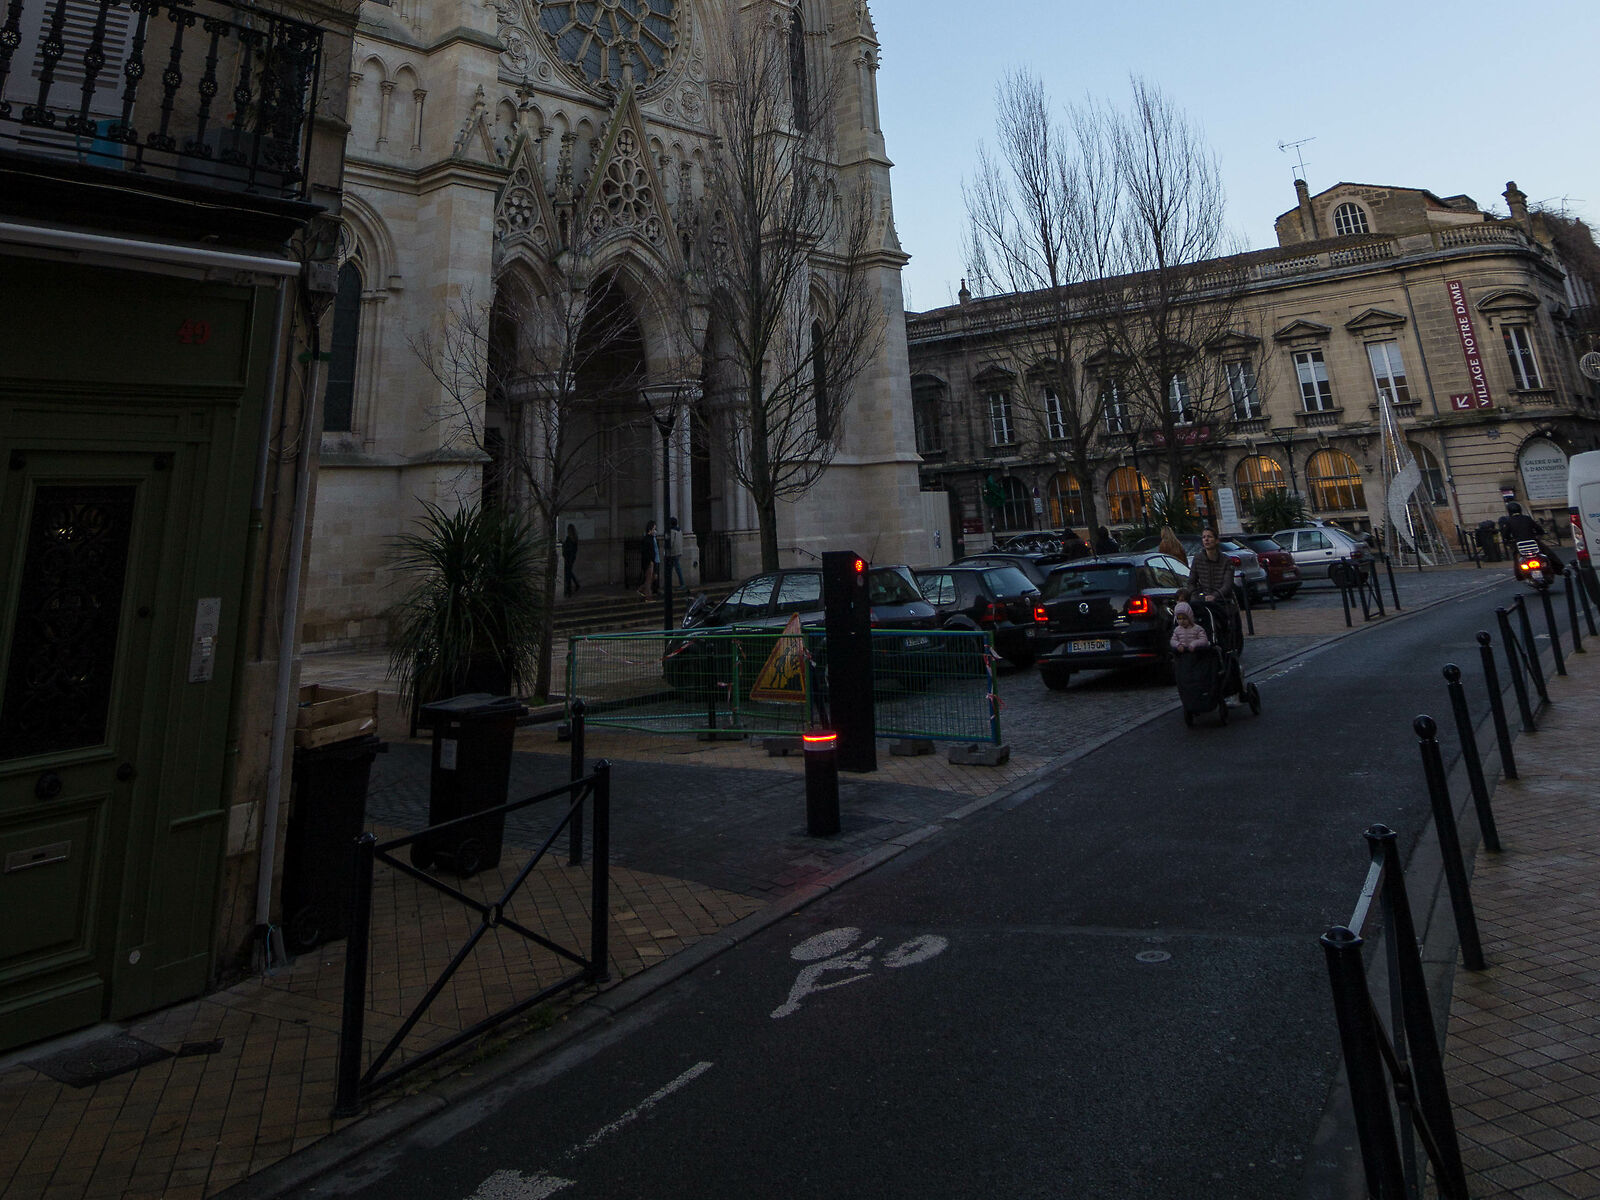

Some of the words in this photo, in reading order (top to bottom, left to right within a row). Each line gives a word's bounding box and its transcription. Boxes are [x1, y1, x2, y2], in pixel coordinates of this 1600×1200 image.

[1450, 282, 1467, 314] DAME
[176, 318, 211, 344] 49
[1460, 317, 1477, 355] NOTRE
[1470, 358, 1489, 406] VILLAGE
